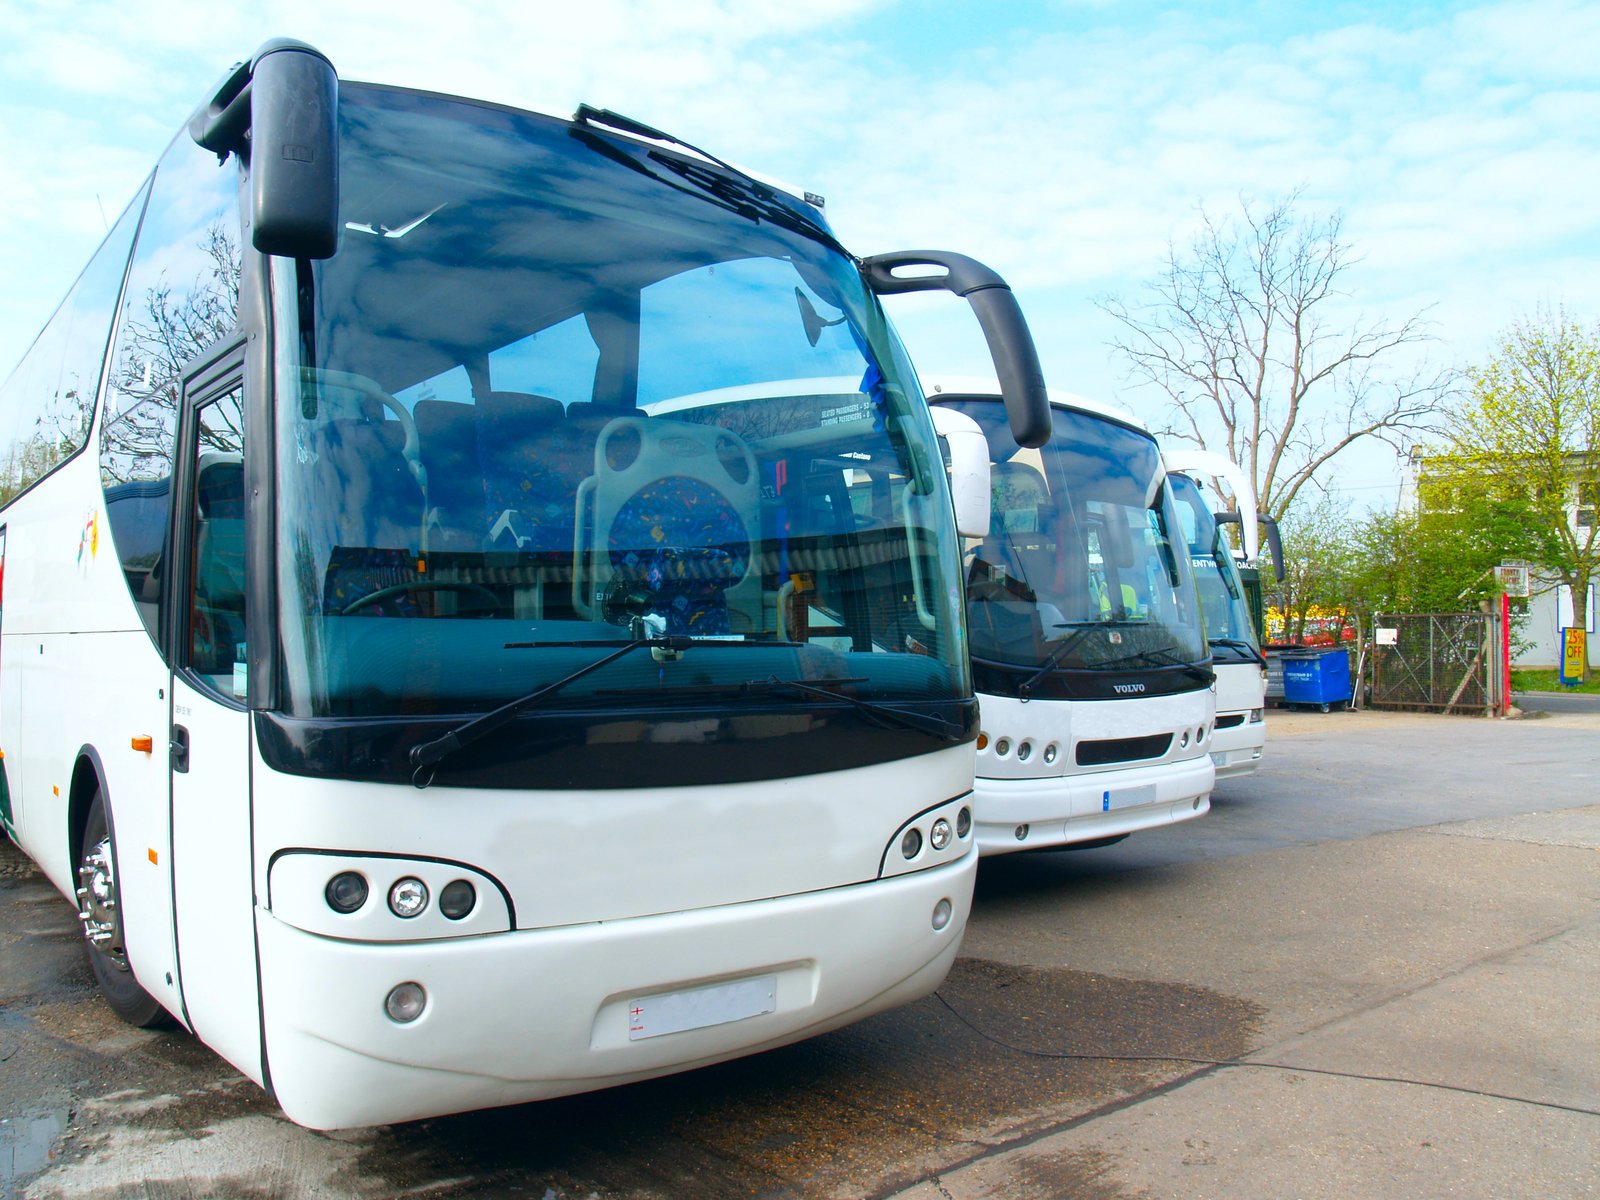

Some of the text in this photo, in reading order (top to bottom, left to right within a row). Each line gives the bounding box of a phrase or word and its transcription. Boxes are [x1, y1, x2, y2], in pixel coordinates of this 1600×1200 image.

[1568, 630, 1583, 644] 25%
[1567, 646, 1581, 657] OFF
[1113, 684, 1145, 693] VOLVO
